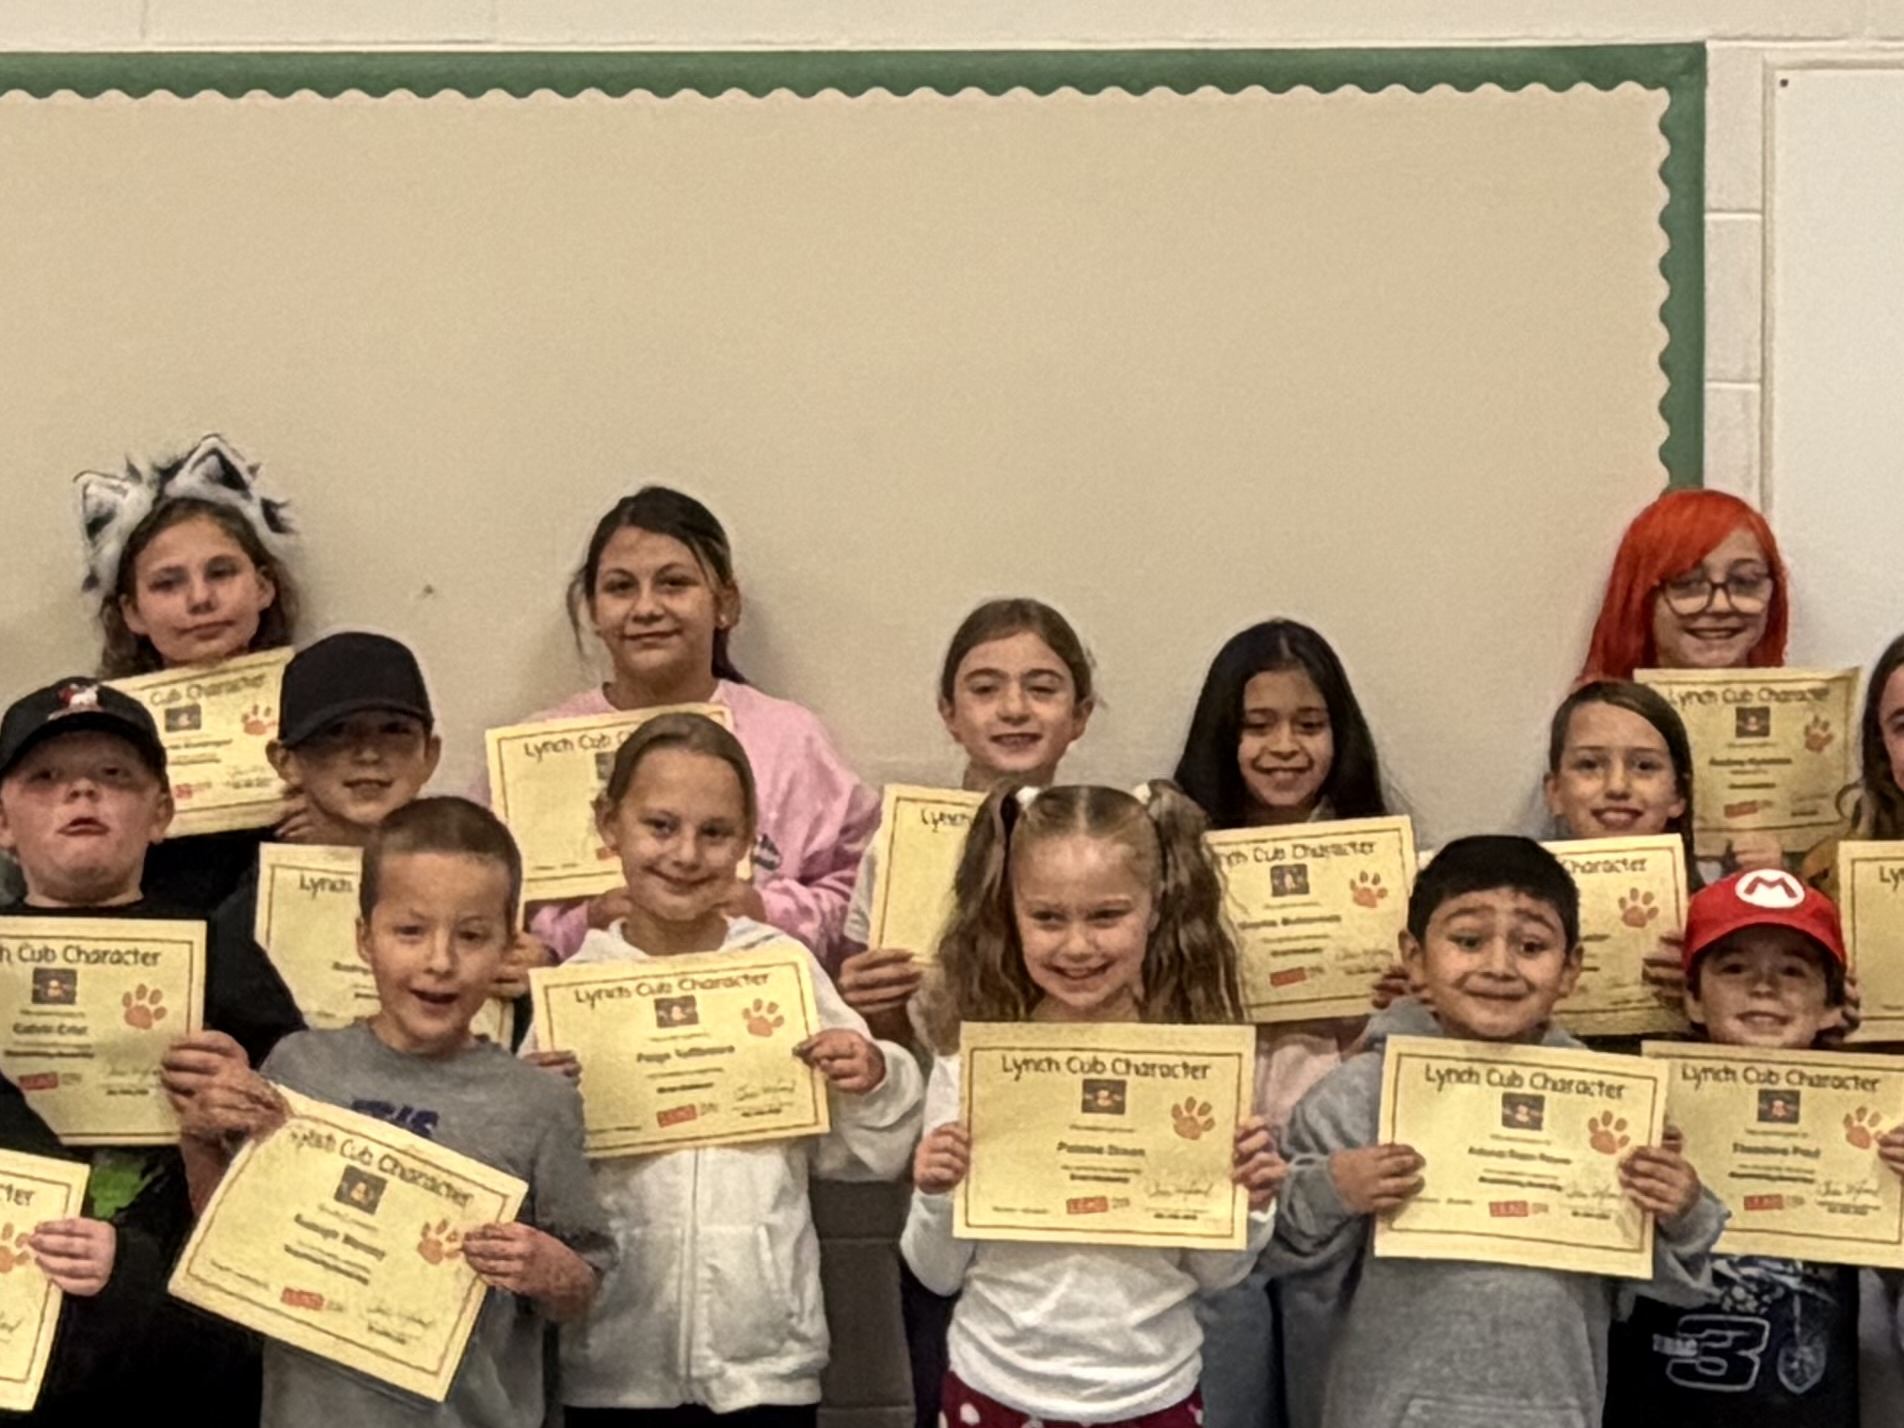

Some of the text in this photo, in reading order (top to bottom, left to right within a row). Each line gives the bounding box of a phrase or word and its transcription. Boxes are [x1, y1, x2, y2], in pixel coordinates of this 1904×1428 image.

[578, 732, 611, 750] Cub
[1744, 876, 1798, 899] M
[17, 943, 57, 963] Cub
[636, 982, 672, 997] Cub
[1066, 1056, 1106, 1074] Cub
[1486, 1068, 1524, 1089] Cub
[1743, 1066, 1780, 1085] Cub
